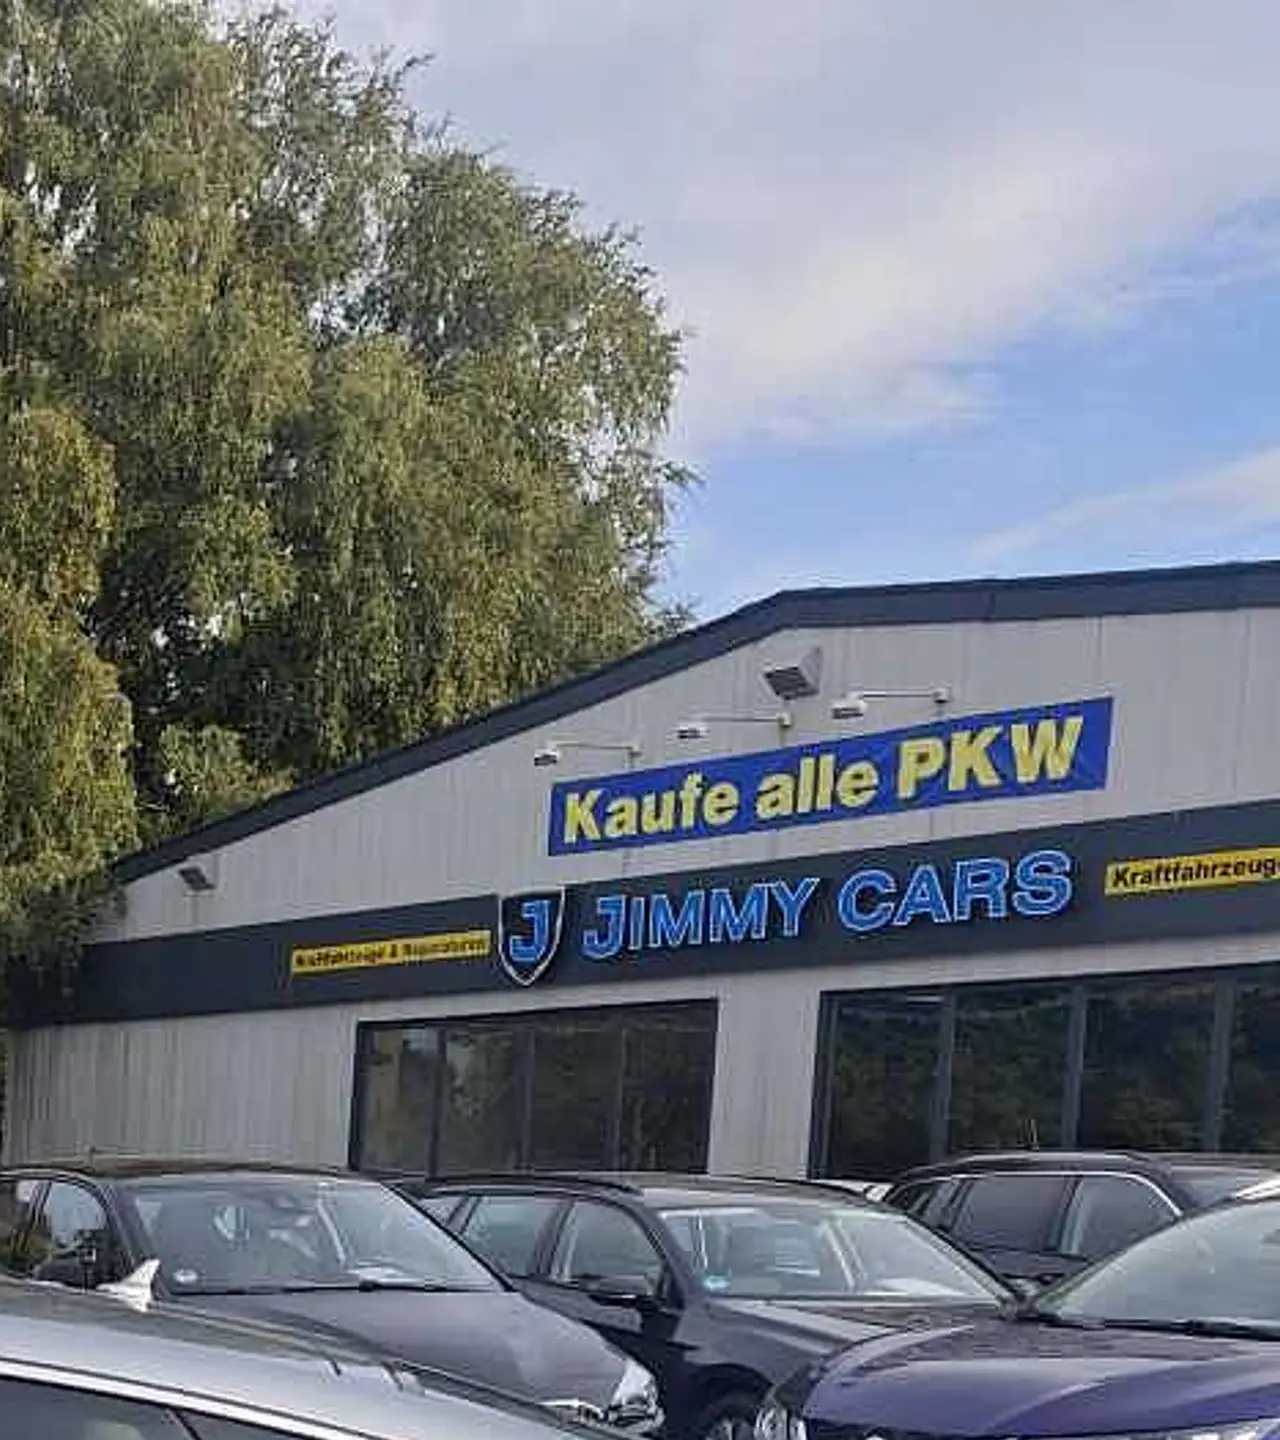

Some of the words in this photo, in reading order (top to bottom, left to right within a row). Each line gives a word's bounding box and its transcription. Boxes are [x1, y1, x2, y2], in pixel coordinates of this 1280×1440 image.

[563, 771, 738, 844] Kaufe
[754, 752, 880, 820] alle
[896, 714, 1085, 799] PKW
[581, 875, 820, 961] JIMMY
[838, 849, 1073, 933] CARS
[1112, 857, 1280, 888] Kraftfahrzeug
[509, 898, 552, 963] J
